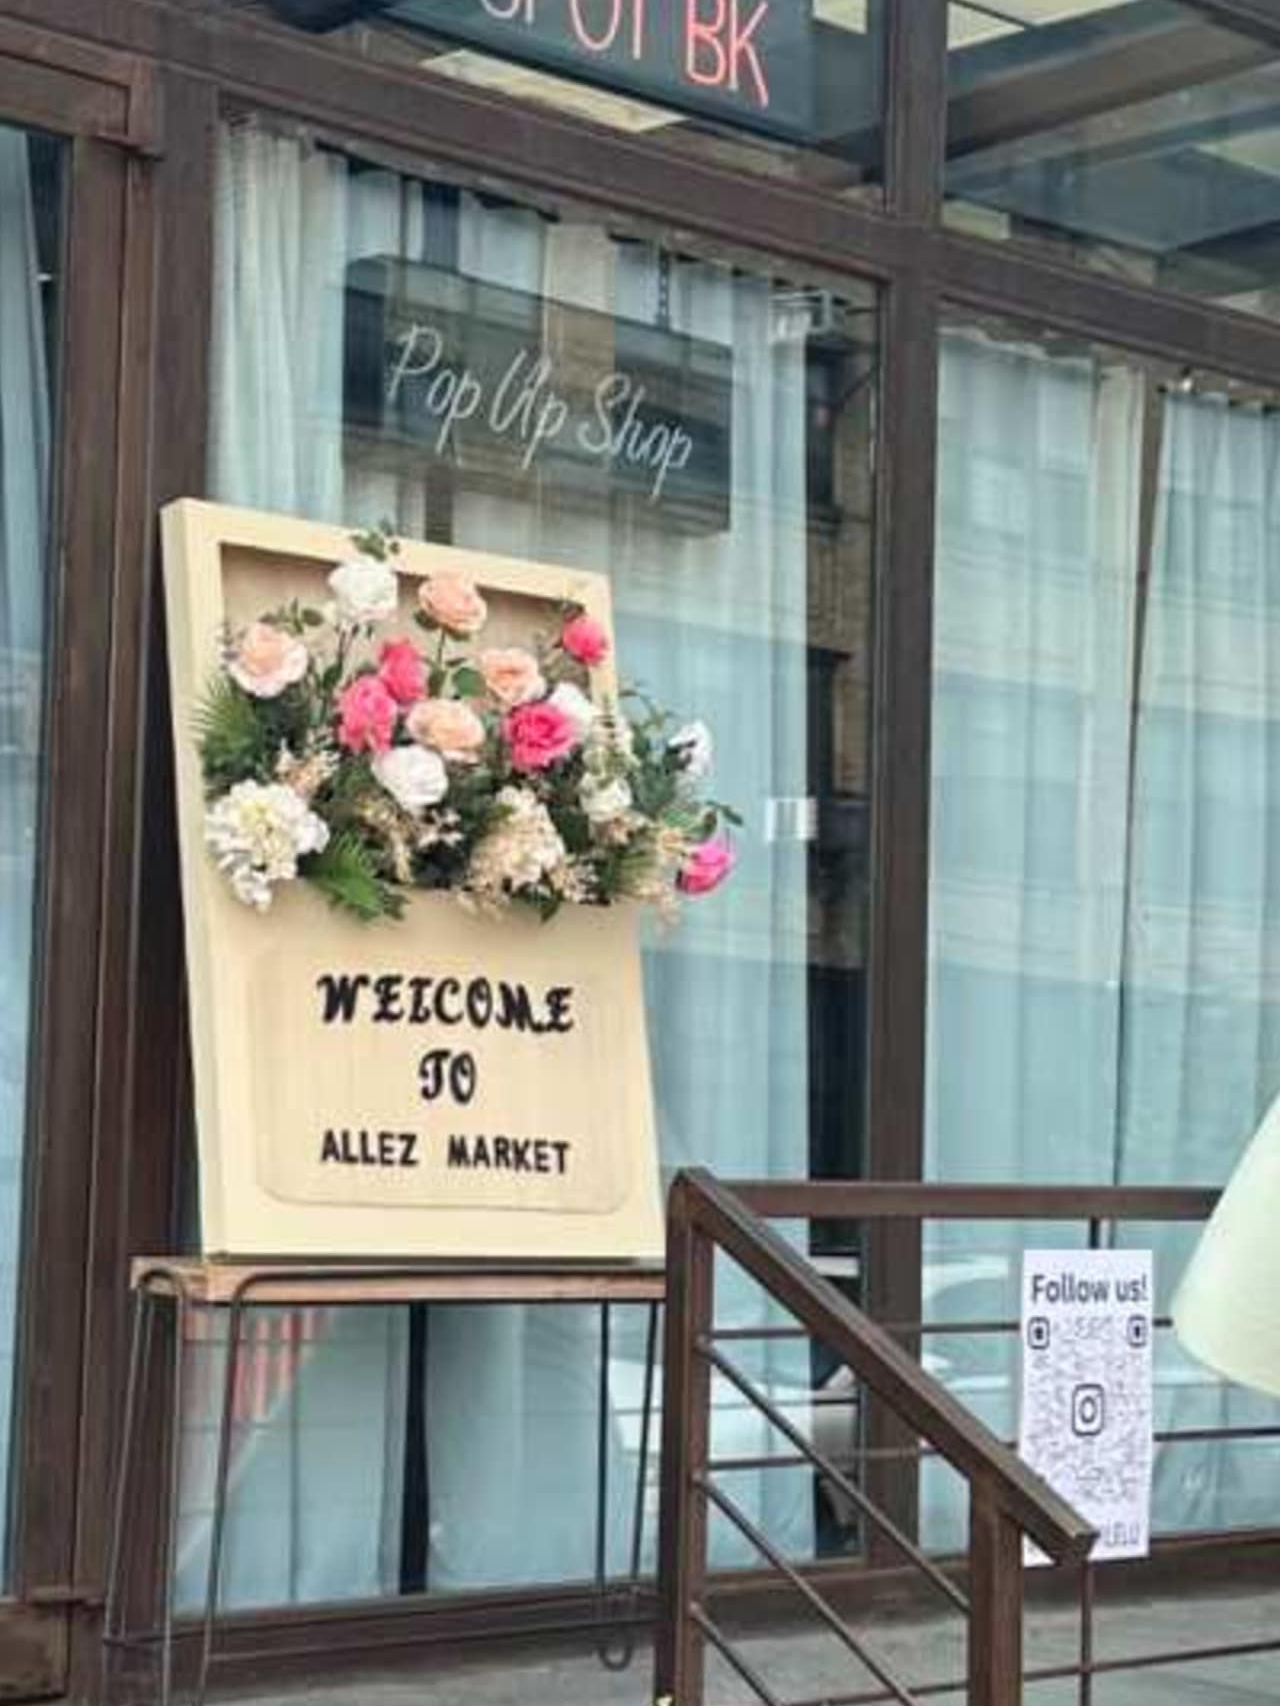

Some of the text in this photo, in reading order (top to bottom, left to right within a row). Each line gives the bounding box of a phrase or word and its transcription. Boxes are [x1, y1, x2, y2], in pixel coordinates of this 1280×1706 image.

[388, 324, 693, 505] Pop Up Shop
[316, 974, 574, 1034] WELCOME
[418, 1048, 477, 1105] TO
[320, 1129, 572, 1175] ALLEZ MARKET
[1031, 1271, 1149, 1304] Follow us!
